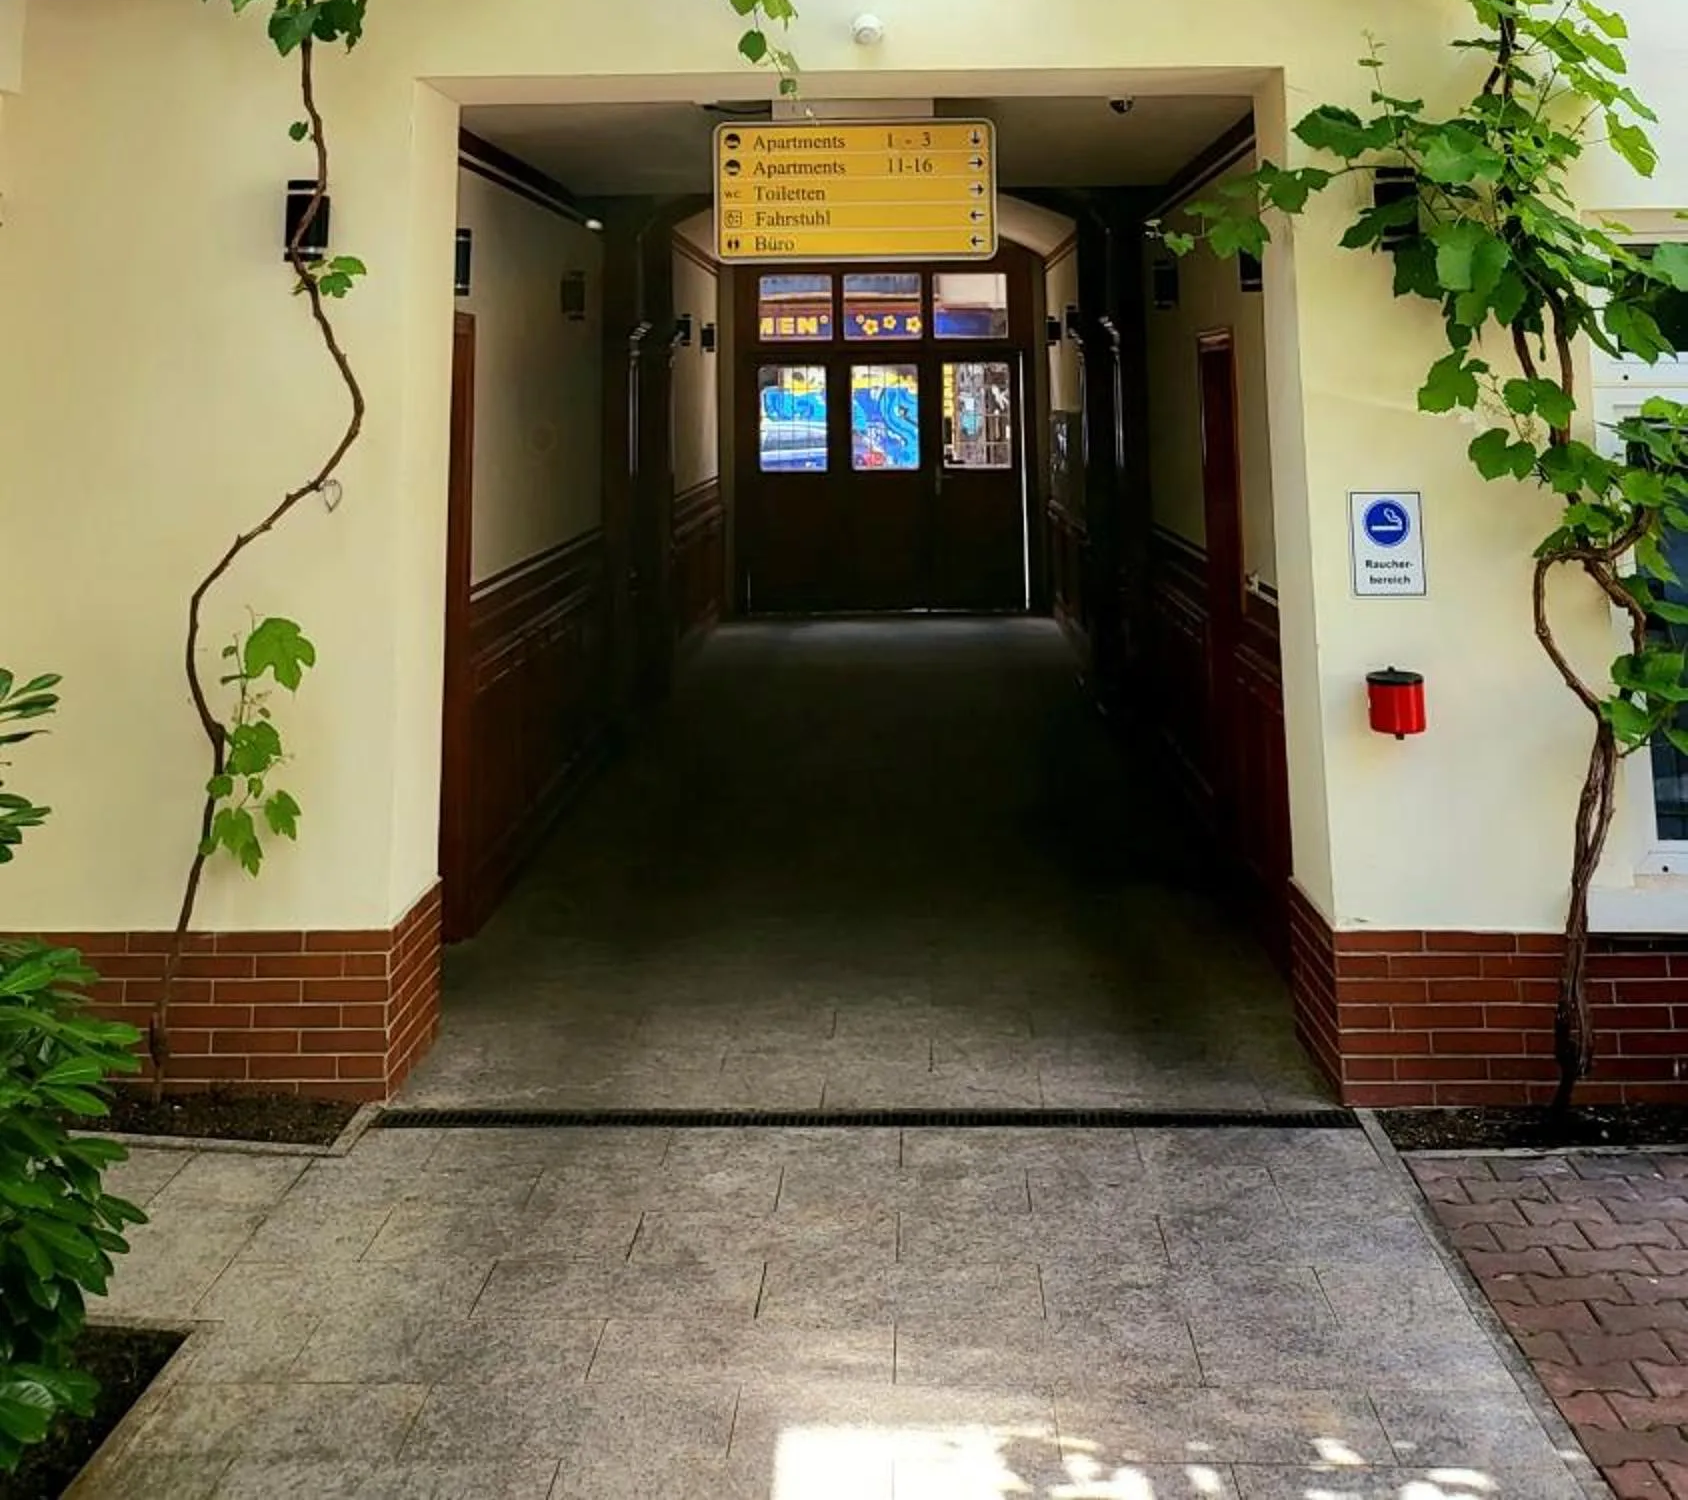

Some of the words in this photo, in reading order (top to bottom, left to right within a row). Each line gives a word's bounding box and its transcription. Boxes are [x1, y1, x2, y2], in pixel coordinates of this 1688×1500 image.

[753, 134, 846, 153] Apartments
[920, 132, 932, 148] 3
[753, 160, 847, 179] Apartments
[886, 157, 933, 174] 11-16
[724, 190, 741, 199] WC
[753, 185, 826, 202] Toiletten
[755, 210, 831, 227] Fahrstuhl
[754, 235, 795, 252] Büro
[1365, 559, 1415, 569] Raucher-
[1369, 574, 1411, 585] bereich
